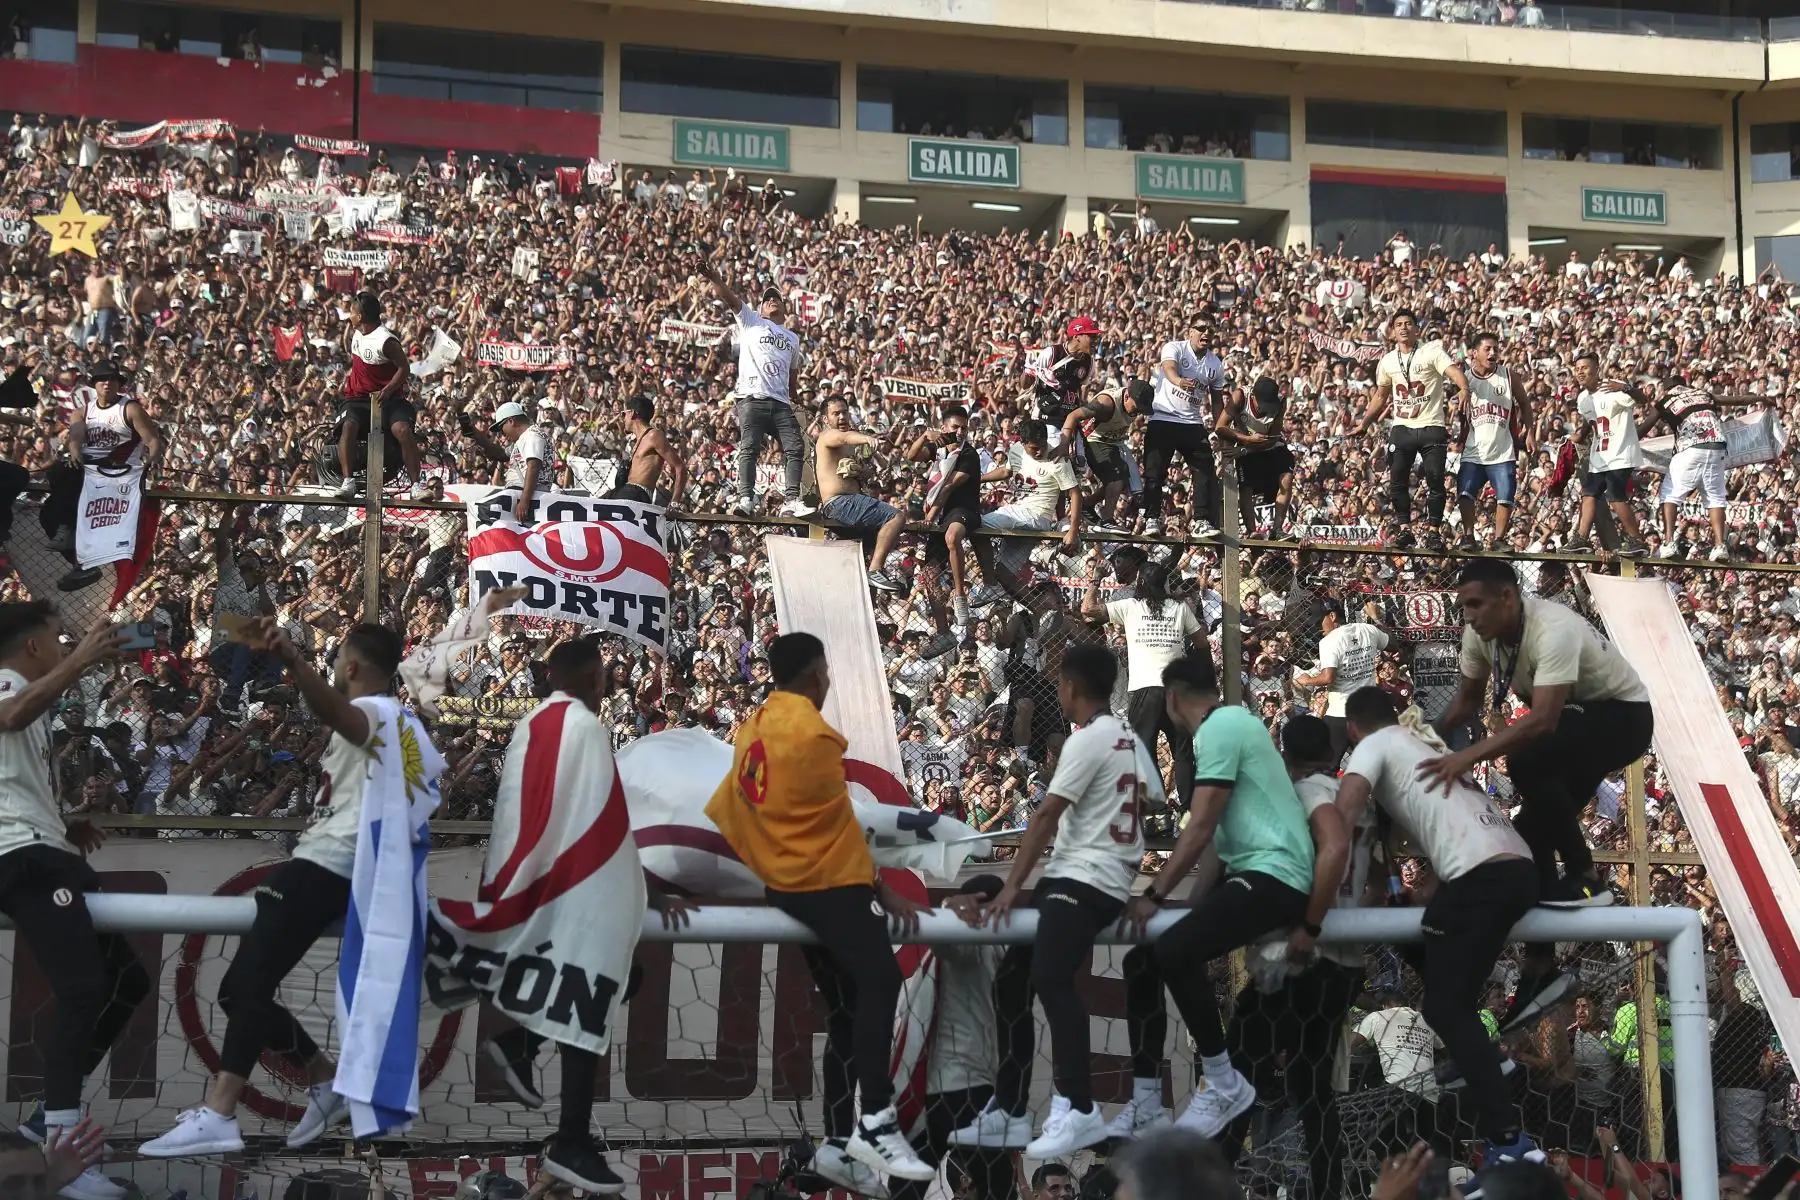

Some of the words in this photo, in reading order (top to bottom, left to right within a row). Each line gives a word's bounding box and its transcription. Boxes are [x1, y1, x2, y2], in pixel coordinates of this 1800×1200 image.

[687, 129, 778, 160] SALIDA
[920, 148, 1009, 178] SALIDA
[1148, 164, 1233, 193] SALIDA
[1591, 194, 1658, 218] SALIDA
[58, 221, 88, 240] 27
[800, 292, 817, 322] E
[480, 343, 505, 363] OASIS
[526, 347, 554, 365] NORTE
[1207, 366, 1216, 380] U
[543, 526, 605, 572] U
[474, 569, 666, 648] NORTE
[1109, 772, 1140, 845] 3
